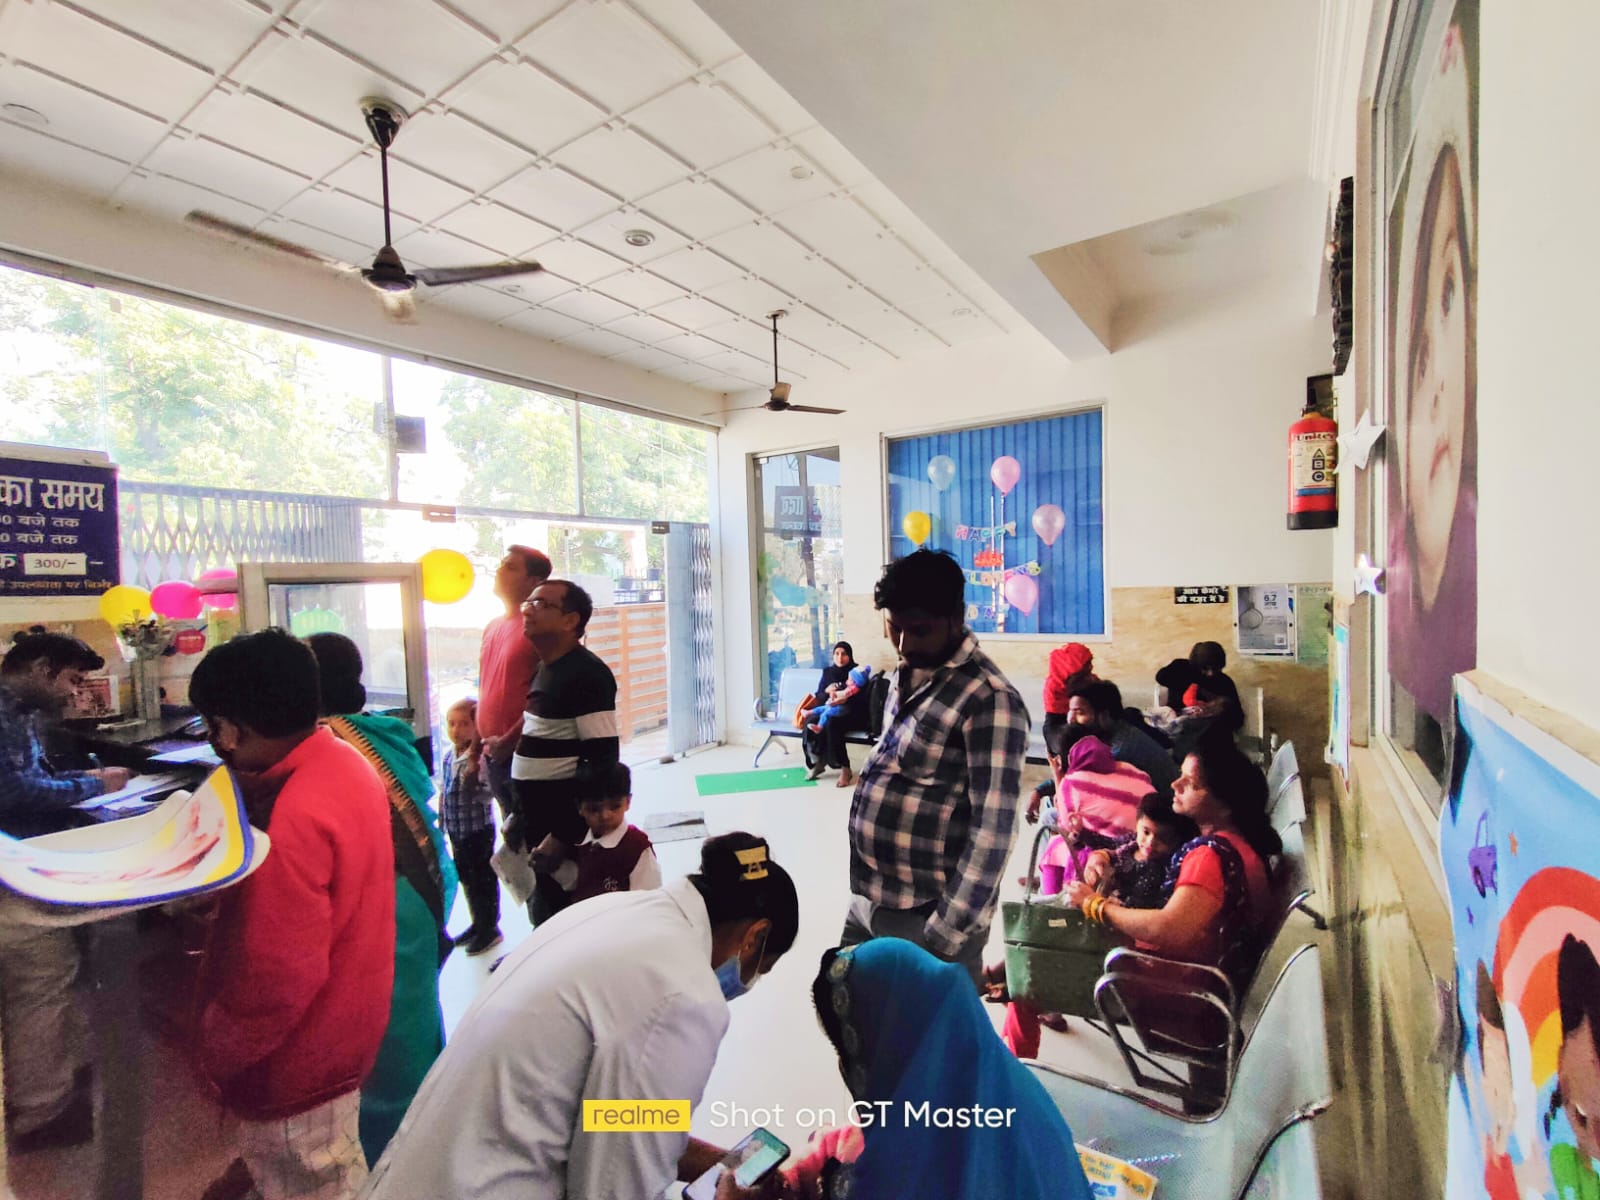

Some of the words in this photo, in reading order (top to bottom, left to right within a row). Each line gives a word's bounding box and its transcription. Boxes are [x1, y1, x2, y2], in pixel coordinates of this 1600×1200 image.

[39, 478, 105, 512] समय
[17, 512, 46, 527] बजे
[51, 517, 80, 528] तक
[16, 530, 45, 544] बजे
[50, 534, 79, 545] तक
